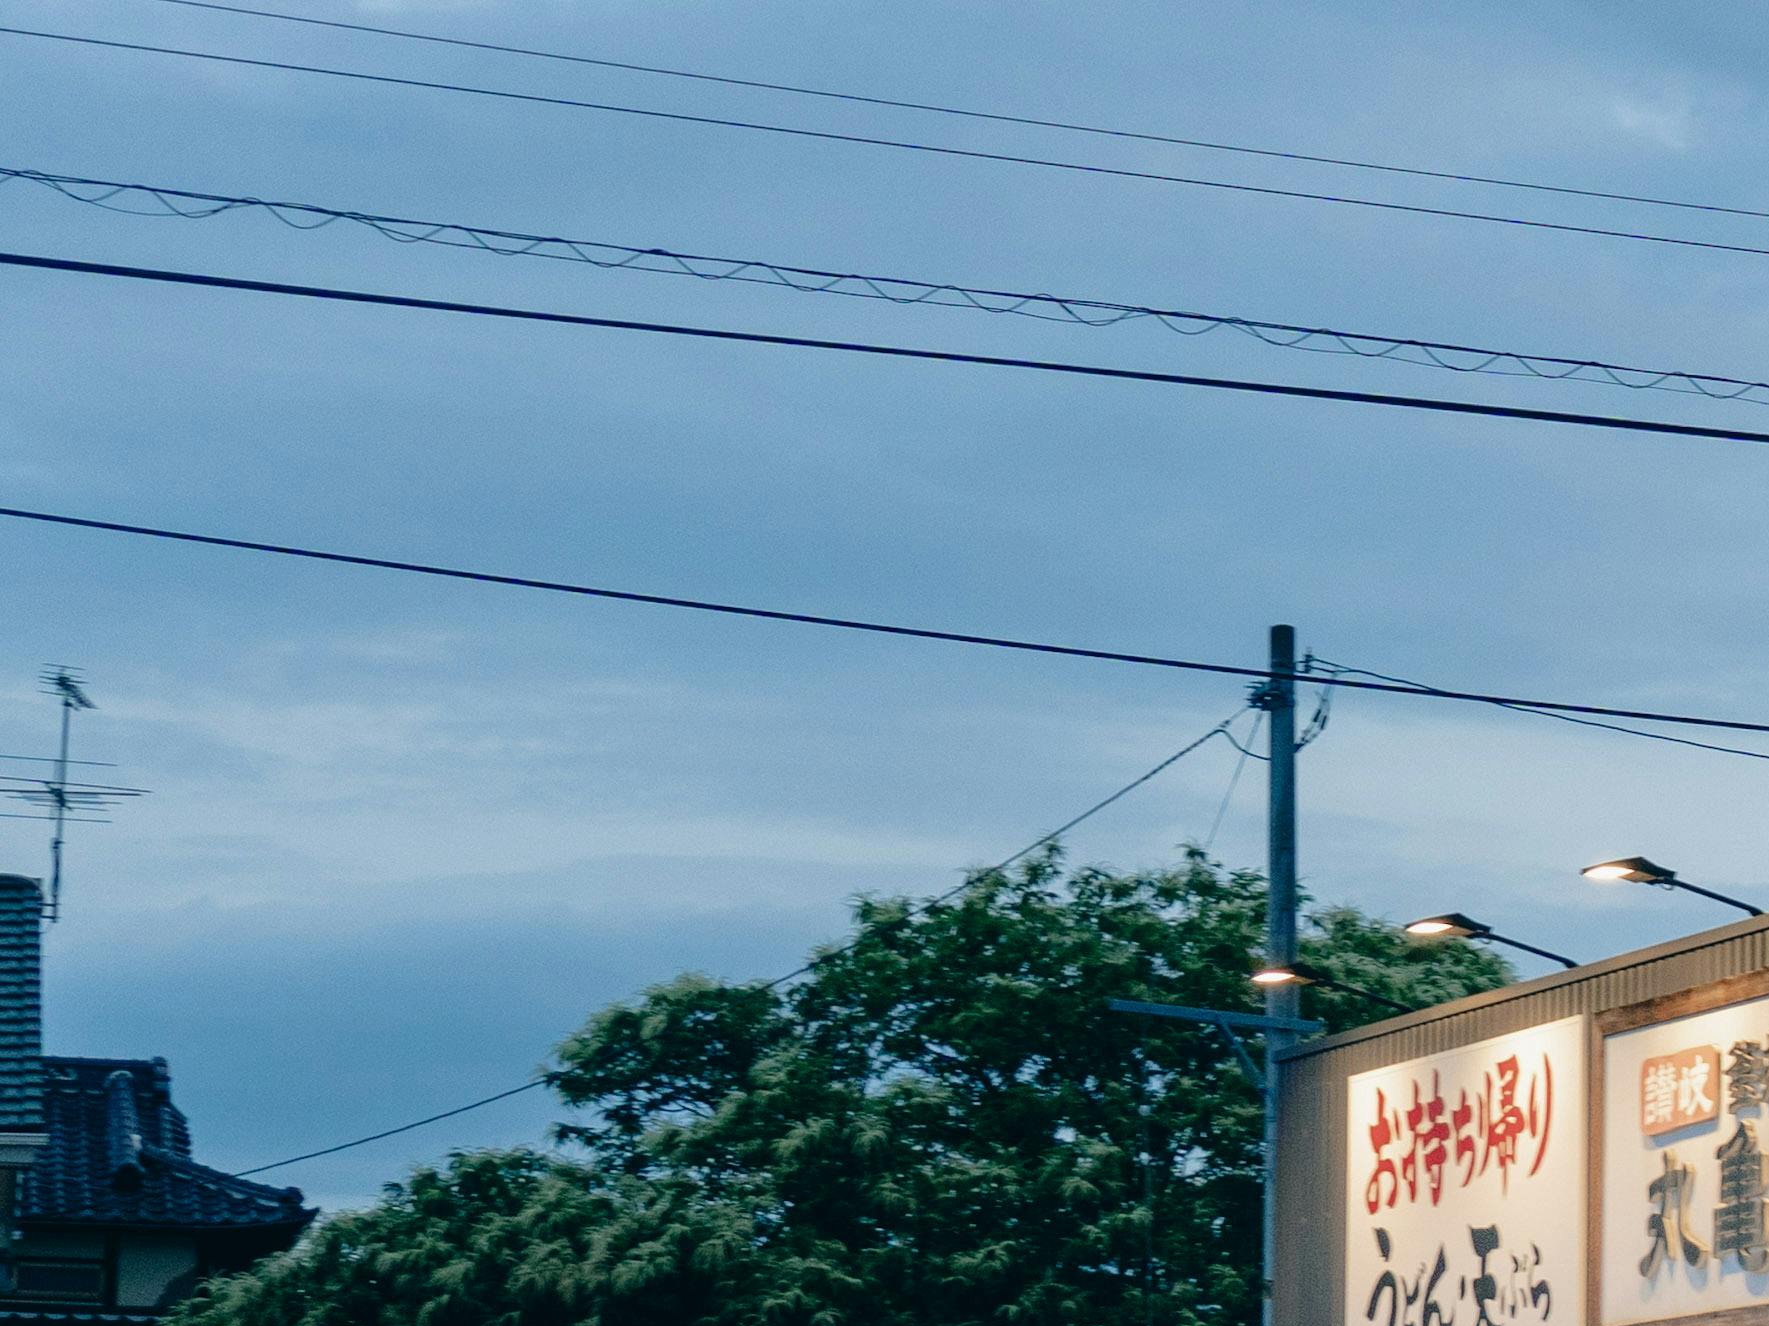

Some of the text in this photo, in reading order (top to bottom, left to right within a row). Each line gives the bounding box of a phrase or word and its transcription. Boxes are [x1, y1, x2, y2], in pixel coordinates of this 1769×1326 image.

[1366, 1052, 1553, 1215] お持ち帰り
[1643, 1055, 1714, 1126] 讃岐
